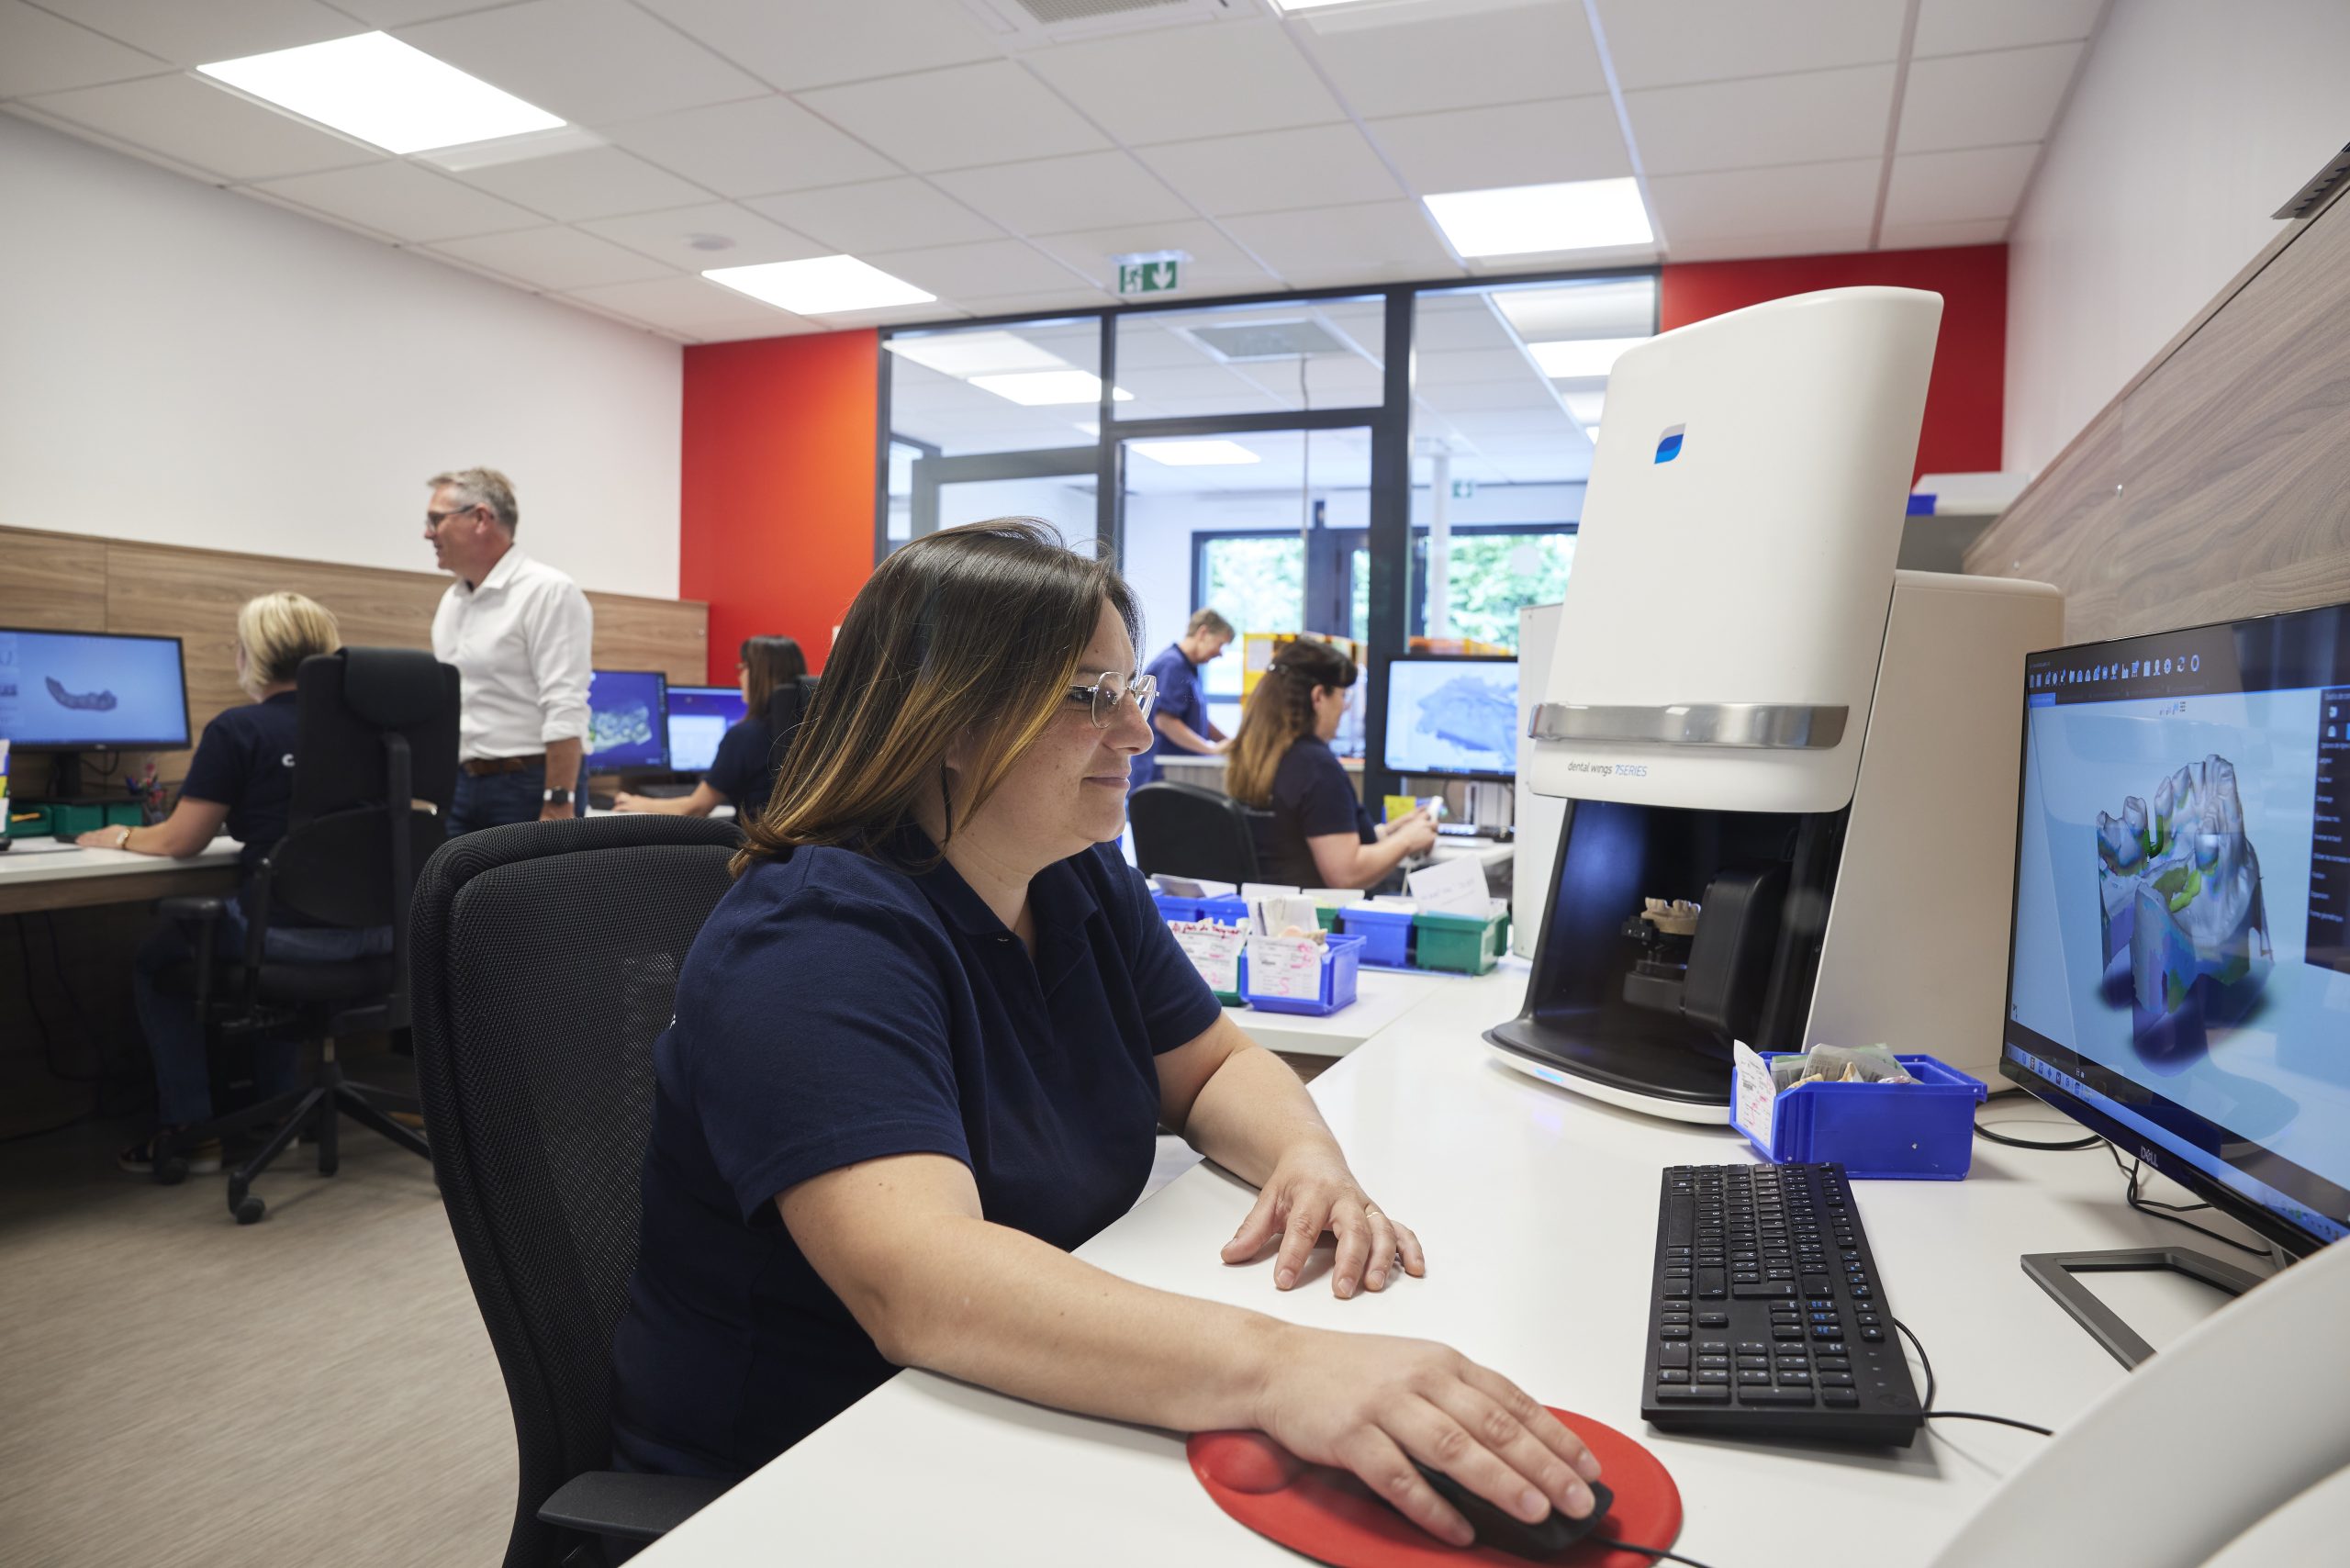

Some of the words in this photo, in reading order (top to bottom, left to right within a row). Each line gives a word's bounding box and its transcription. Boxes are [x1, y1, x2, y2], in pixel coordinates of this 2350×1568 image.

[1568, 761, 1591, 772] dental
[1591, 765, 1613, 777] wings
[1616, 765, 1648, 777] 7SERIES
[2141, 1146, 2158, 1168] DELL
